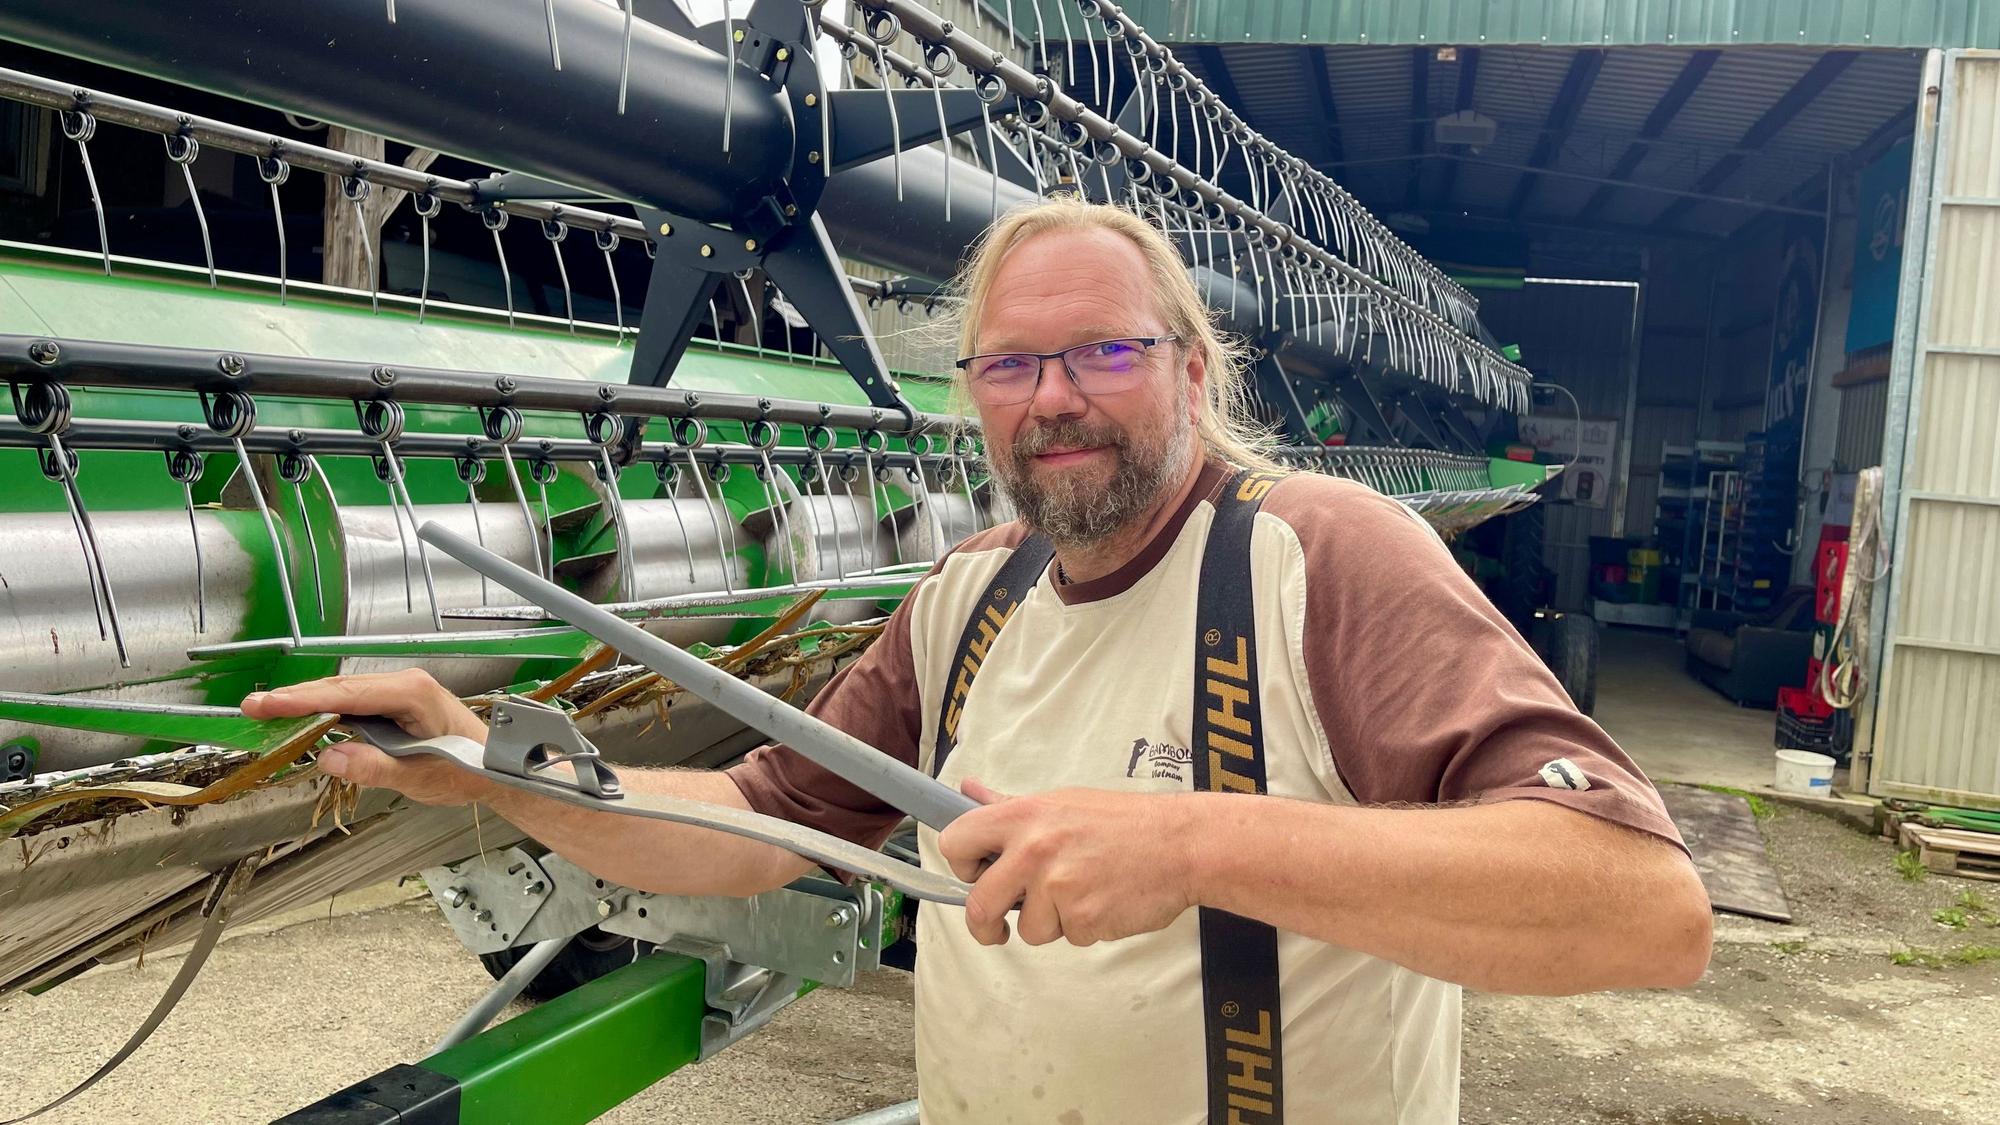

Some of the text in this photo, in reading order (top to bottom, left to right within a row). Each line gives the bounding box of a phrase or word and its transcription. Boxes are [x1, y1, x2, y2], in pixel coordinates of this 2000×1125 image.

[1206, 636, 1257, 793] TIHL
[1151, 769, 1183, 782] Vietnam
[1225, 1009, 1273, 1125] IHL
